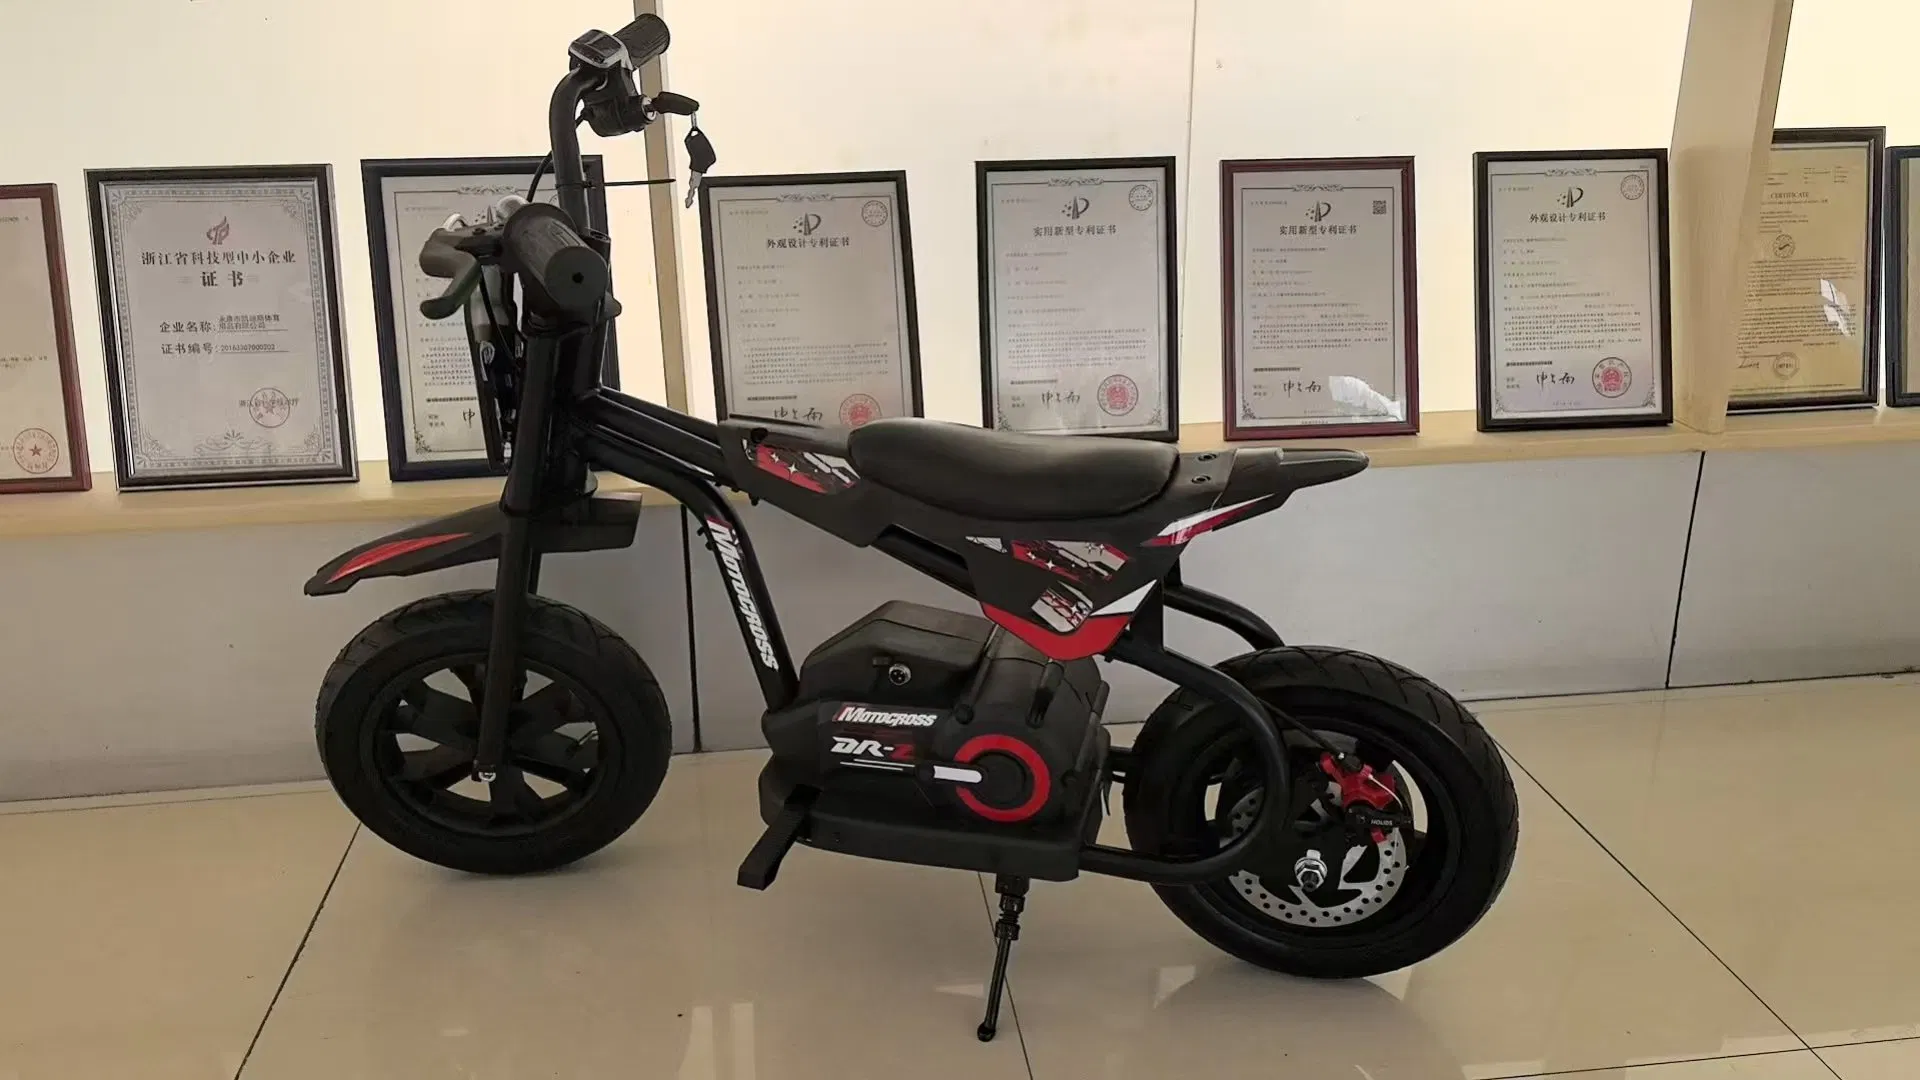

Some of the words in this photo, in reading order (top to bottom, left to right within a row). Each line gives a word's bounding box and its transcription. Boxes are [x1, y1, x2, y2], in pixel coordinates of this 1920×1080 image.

[1529, 212, 1606, 224] 外观设计专利证书
[1033, 224, 1118, 237] 实用新型专利证书
[1279, 224, 1358, 236] 实用新型专利证书
[766, 236, 850, 249] 外观设计专利证书
[141, 250, 297, 266] 浙江省科技型中小企业
[201, 270, 244, 287] 证书
